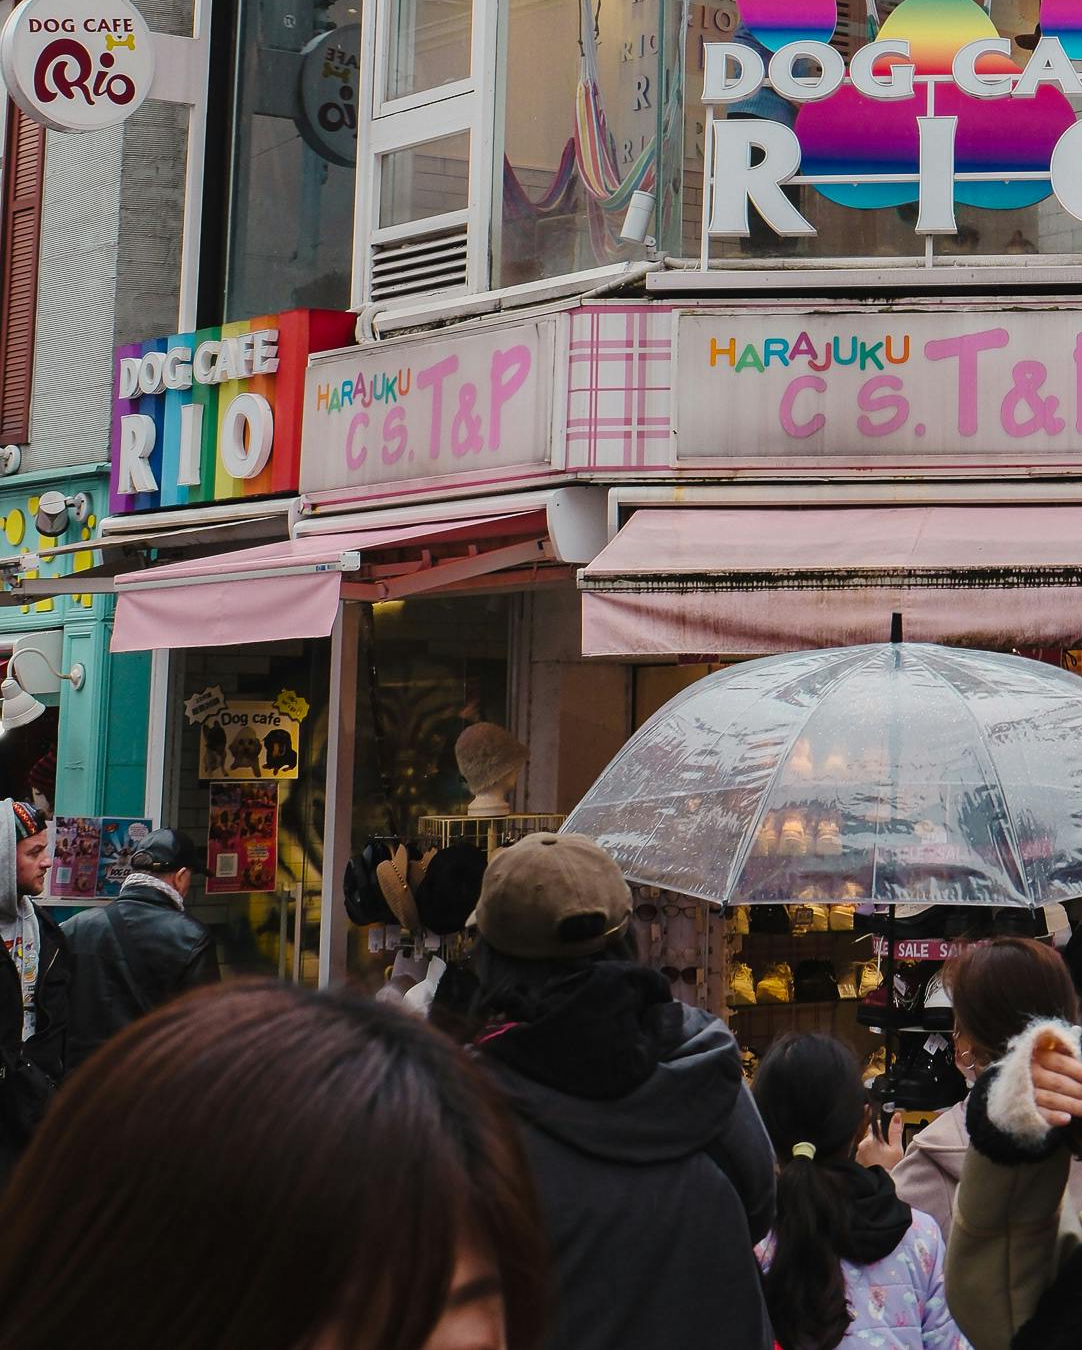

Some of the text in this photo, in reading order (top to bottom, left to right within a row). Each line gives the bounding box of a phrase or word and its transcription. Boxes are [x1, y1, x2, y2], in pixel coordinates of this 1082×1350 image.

[29, 18, 134, 32] DOG CAFE
[34, 38, 135, 105] Rio
[701, 39, 915, 104] DOG
[119, 329, 279, 399] DOG CAFE
[709, 331, 910, 374] HARAJUKU
[317, 368, 411, 415] HARAJUKU
[417, 344, 532, 460] T&P
[117, 393, 274, 494] RIO
[221, 712, 281, 727] Dog cafe
[898, 943, 929, 958] SALE
